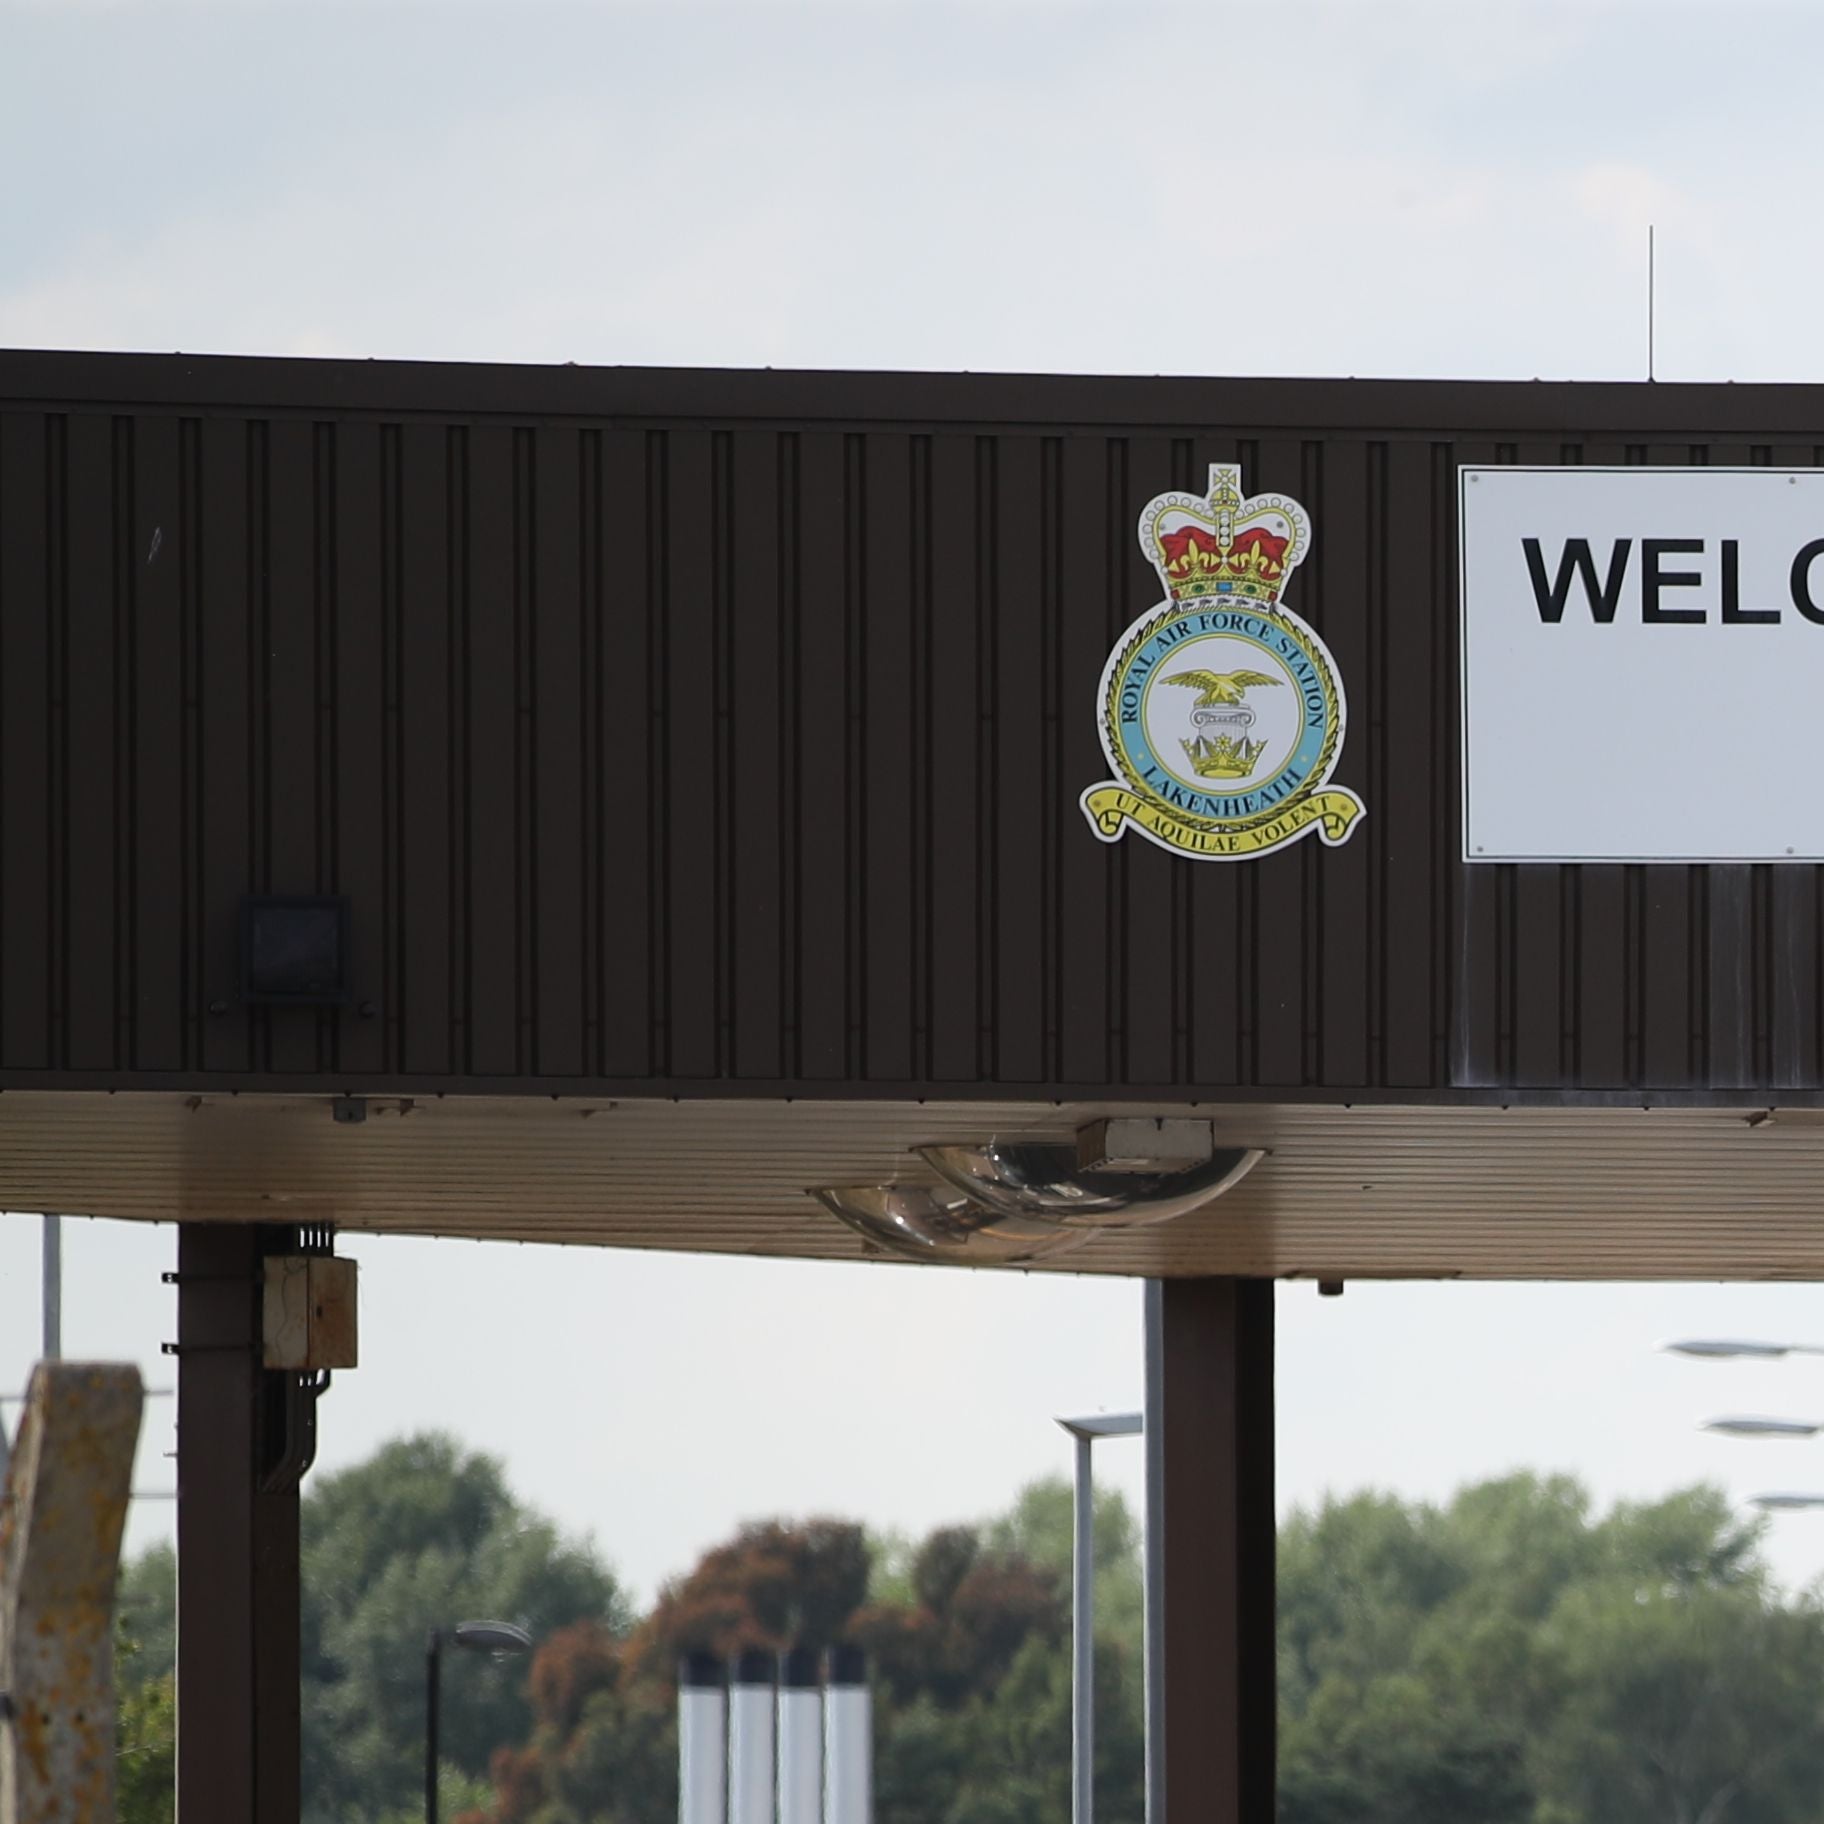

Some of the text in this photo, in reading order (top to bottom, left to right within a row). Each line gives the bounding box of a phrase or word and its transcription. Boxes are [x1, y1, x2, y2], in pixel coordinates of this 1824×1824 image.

[1121, 612, 1323, 728] ROYAL AIR FORCE STATION
[1142, 765, 1303, 817] LAKENHEATH
[1116, 793, 1330, 851] UT AQUILAE VOLENT
